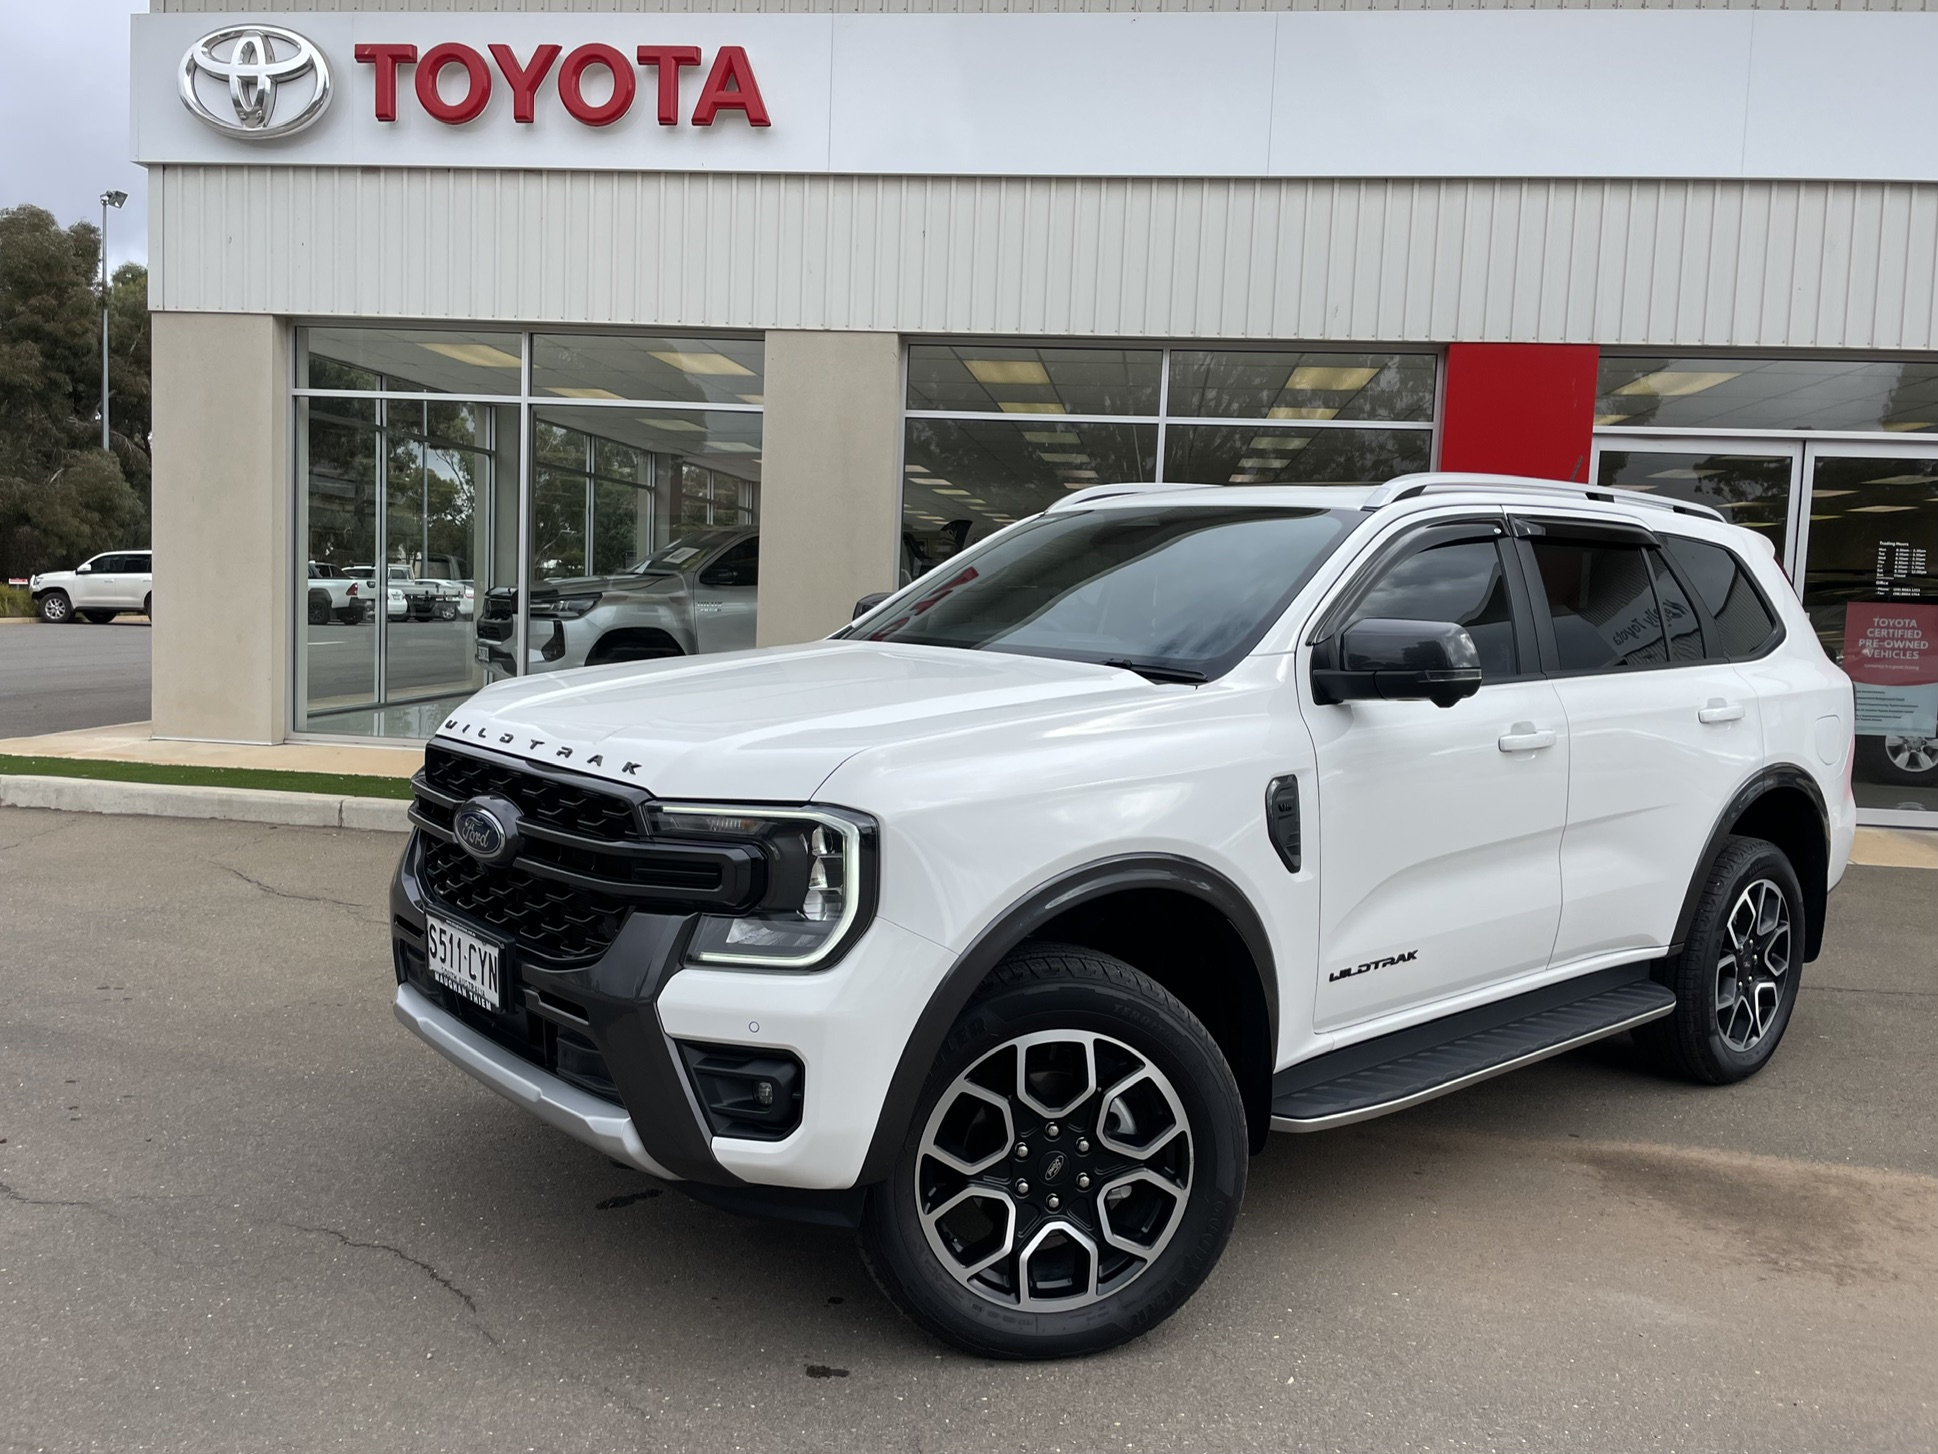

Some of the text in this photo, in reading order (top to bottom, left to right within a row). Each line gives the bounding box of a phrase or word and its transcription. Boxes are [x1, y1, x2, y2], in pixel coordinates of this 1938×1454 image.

[354, 42, 772, 127] TOYOTA
[1873, 618, 1917, 628] TOYOTA
[1867, 628, 1922, 639] CERTIFIED
[1858, 638, 1929, 649] PRE-OWNED
[1866, 649, 1919, 659] VEHICLES
[444, 720, 643, 775] WILDTRAK
[462, 816, 490, 848] Ford
[1329, 949, 1418, 982] WILDTRAK
[469, 992, 492, 1011] THIEM
